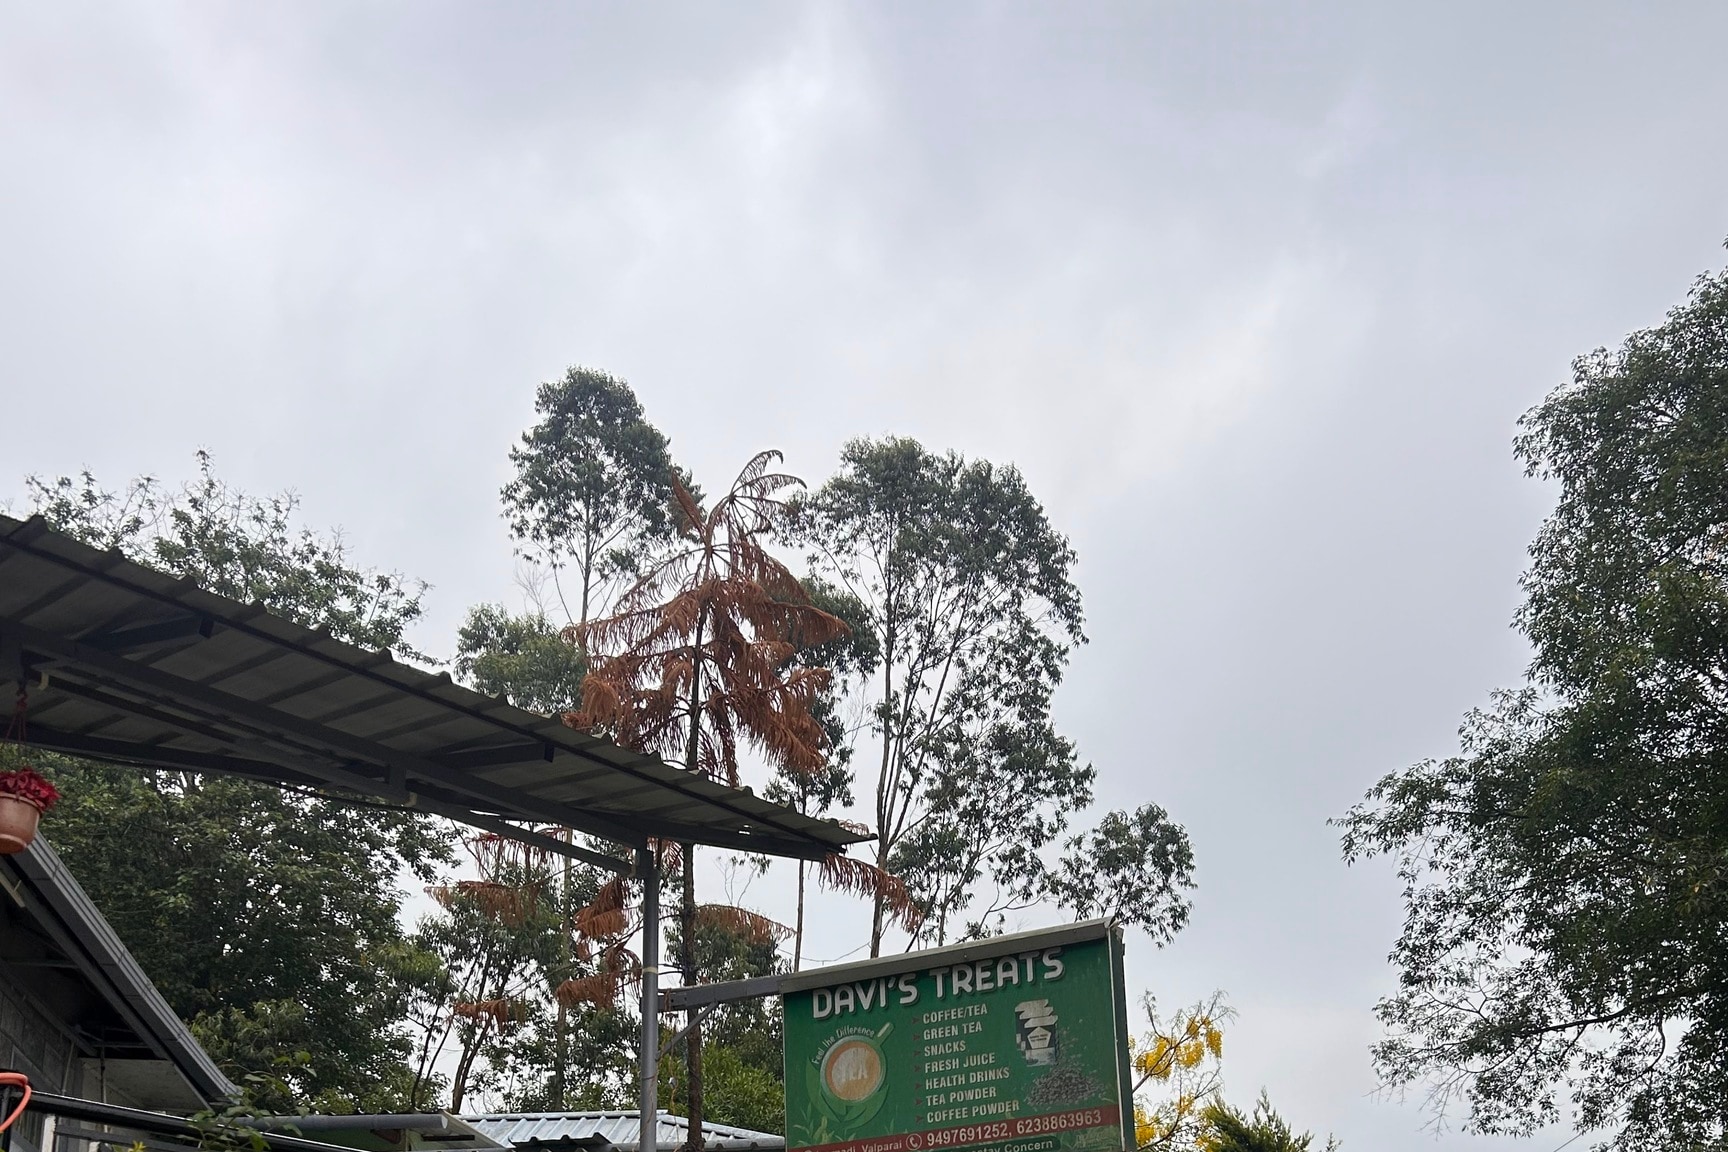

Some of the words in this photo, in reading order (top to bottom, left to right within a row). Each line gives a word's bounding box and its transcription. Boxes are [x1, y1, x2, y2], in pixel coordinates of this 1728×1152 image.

[813, 973, 919, 1019] DAVI'S
[929, 947, 1065, 998] TREATS
[923, 1003, 988, 1024] COFFEE/TEA
[923, 1025, 959, 1040] GREEN
[962, 1021, 983, 1034] TEA
[924, 1040, 967, 1057] SNACKS
[925, 1058, 959, 1073] FRESH
[963, 1052, 996, 1068] JUICE
[925, 1073, 966, 1090] HEALTH
[969, 1067, 1010, 1083] DRINKS
[926, 1093, 946, 1106] TEA
[950, 1086, 997, 1103] POWDER
[927, 1107, 968, 1123] COFFEE
[972, 1099, 1020, 1117] POWDER
[1016, 1109, 1102, 1135] 6238863963
